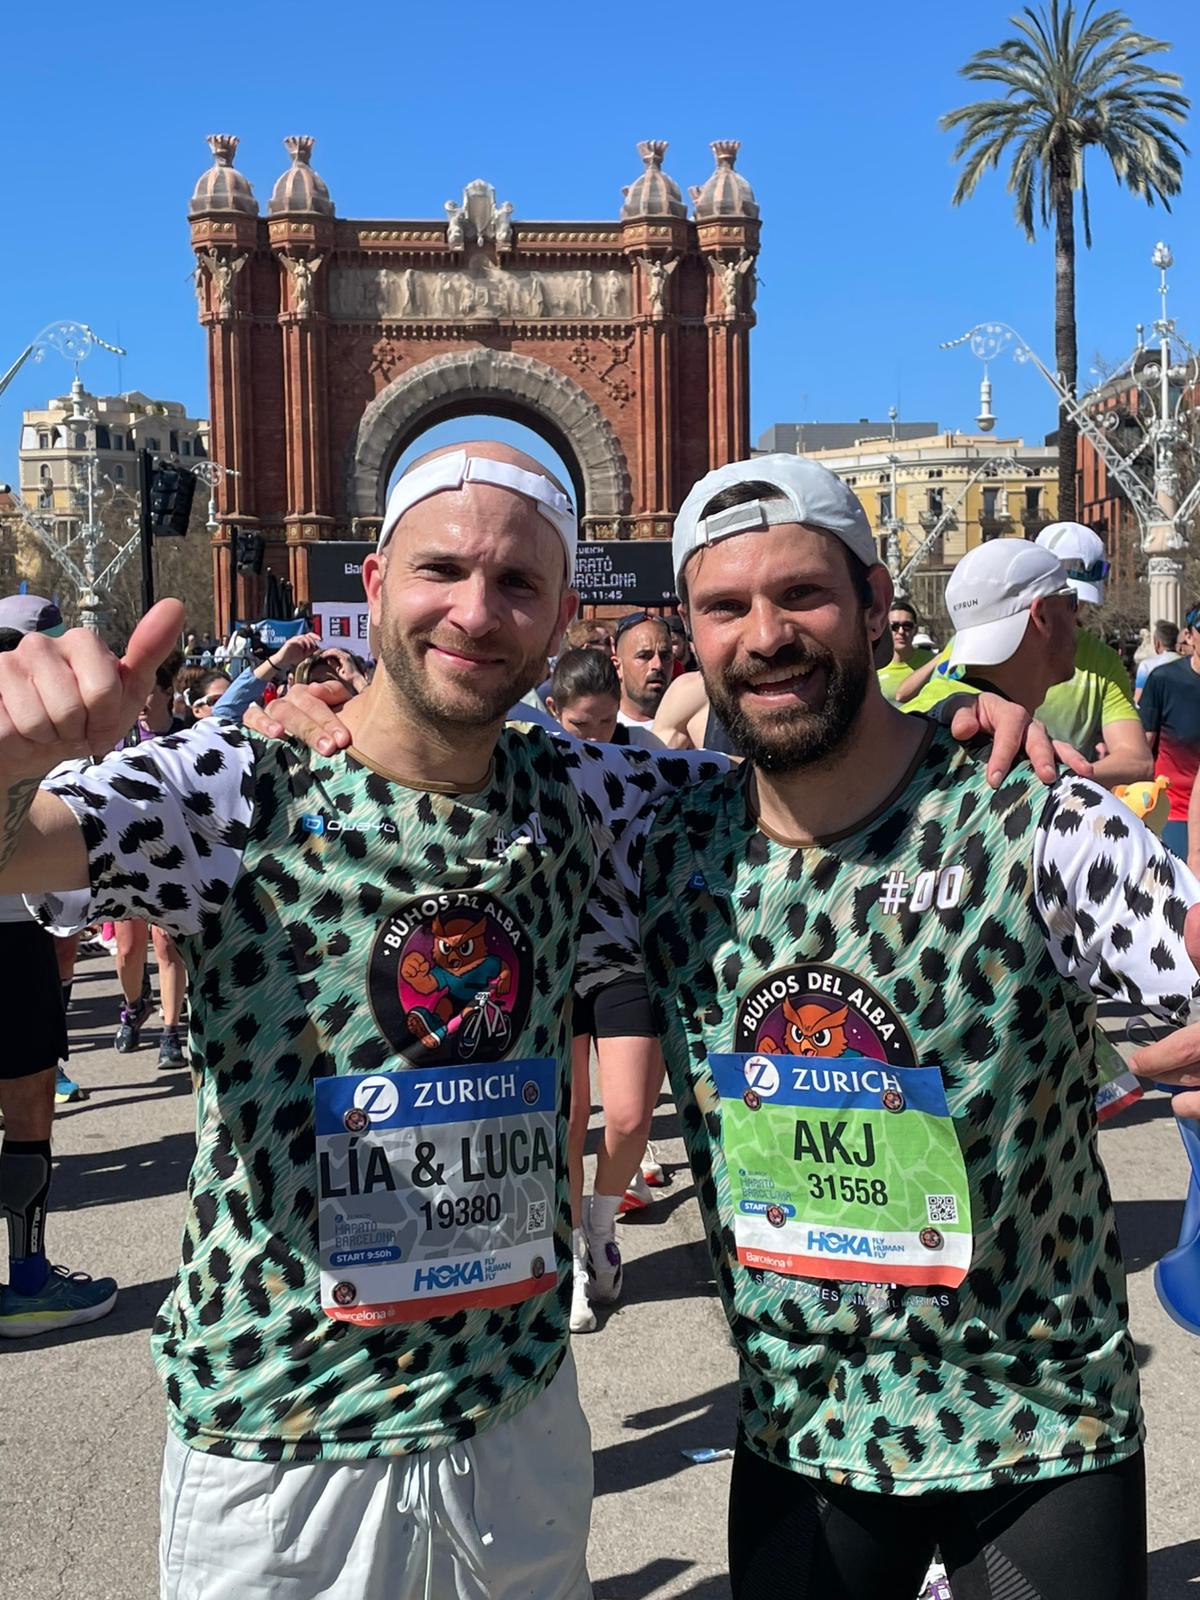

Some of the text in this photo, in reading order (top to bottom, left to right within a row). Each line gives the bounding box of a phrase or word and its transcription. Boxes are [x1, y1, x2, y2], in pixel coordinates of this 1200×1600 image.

[575, 555, 613, 573] RATÓ
[576, 546, 604, 554] URICH
[344, 563, 363, 574] Bar
[569, 573, 637, 588] ARCELONA
[592, 590, 623, 600] 11:45
[879, 865, 965, 915] #00
[384, 894, 449, 949] BÚHOS
[484, 899, 521, 946] ALBA
[743, 972, 896, 1041] BÚHOS DEL ALBA
[413, 1073, 516, 1109] ZURICH
[792, 1068, 903, 1093] ZURICH
[794, 1119, 876, 1168] AKJ
[319, 1126, 554, 1199] LÍA & LUCA
[807, 1172, 889, 1207] 31558
[420, 1192, 502, 1231] 19380
[745, 1202, 767, 1211] START
[336, 1252, 366, 1264] START
[807, 1230, 873, 1258] HOKA
[413, 1259, 484, 1292] HOKA
[484, 1262, 512, 1273] HUMAN
